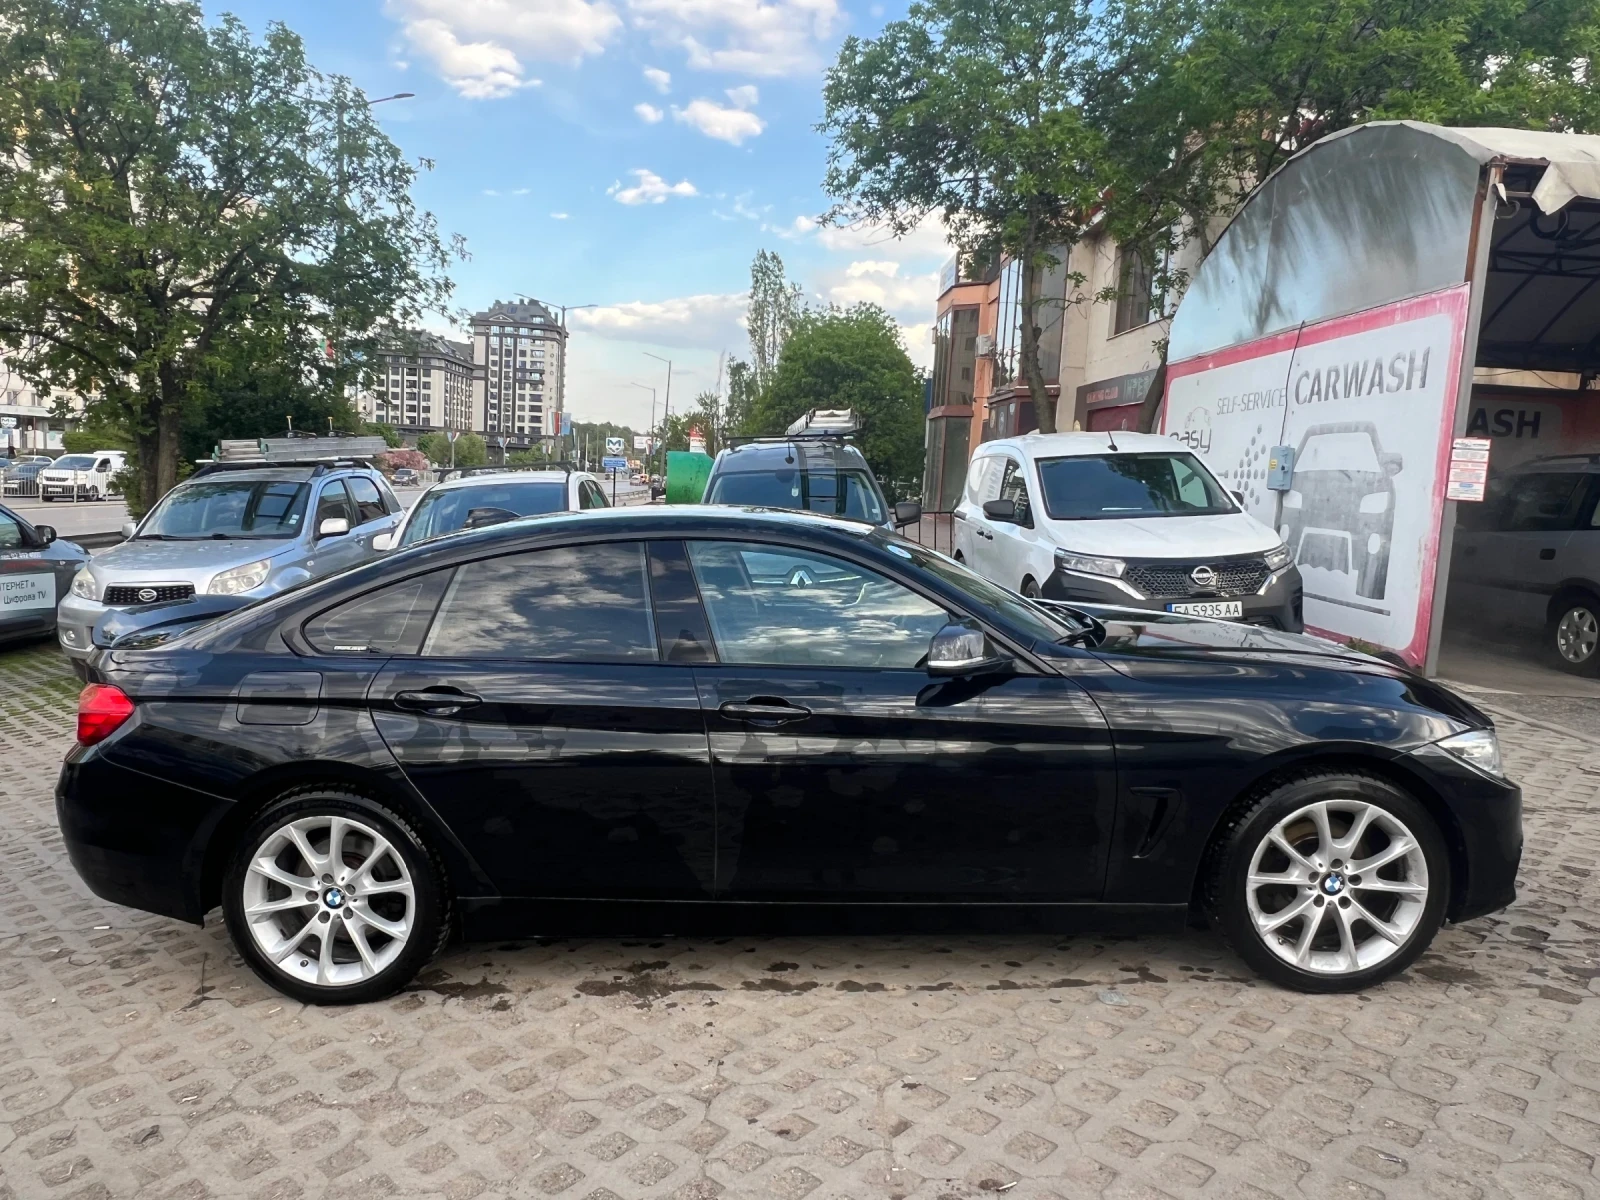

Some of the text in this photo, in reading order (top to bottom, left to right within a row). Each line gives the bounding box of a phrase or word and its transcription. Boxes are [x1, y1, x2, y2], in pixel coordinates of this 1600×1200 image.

[1294, 346, 1430, 405] CARWASH
[1216, 387, 1286, 415] SELF-SERVICE
[1465, 407, 1541, 439] ASH
[4, 591, 46, 604] Цифрова TV
